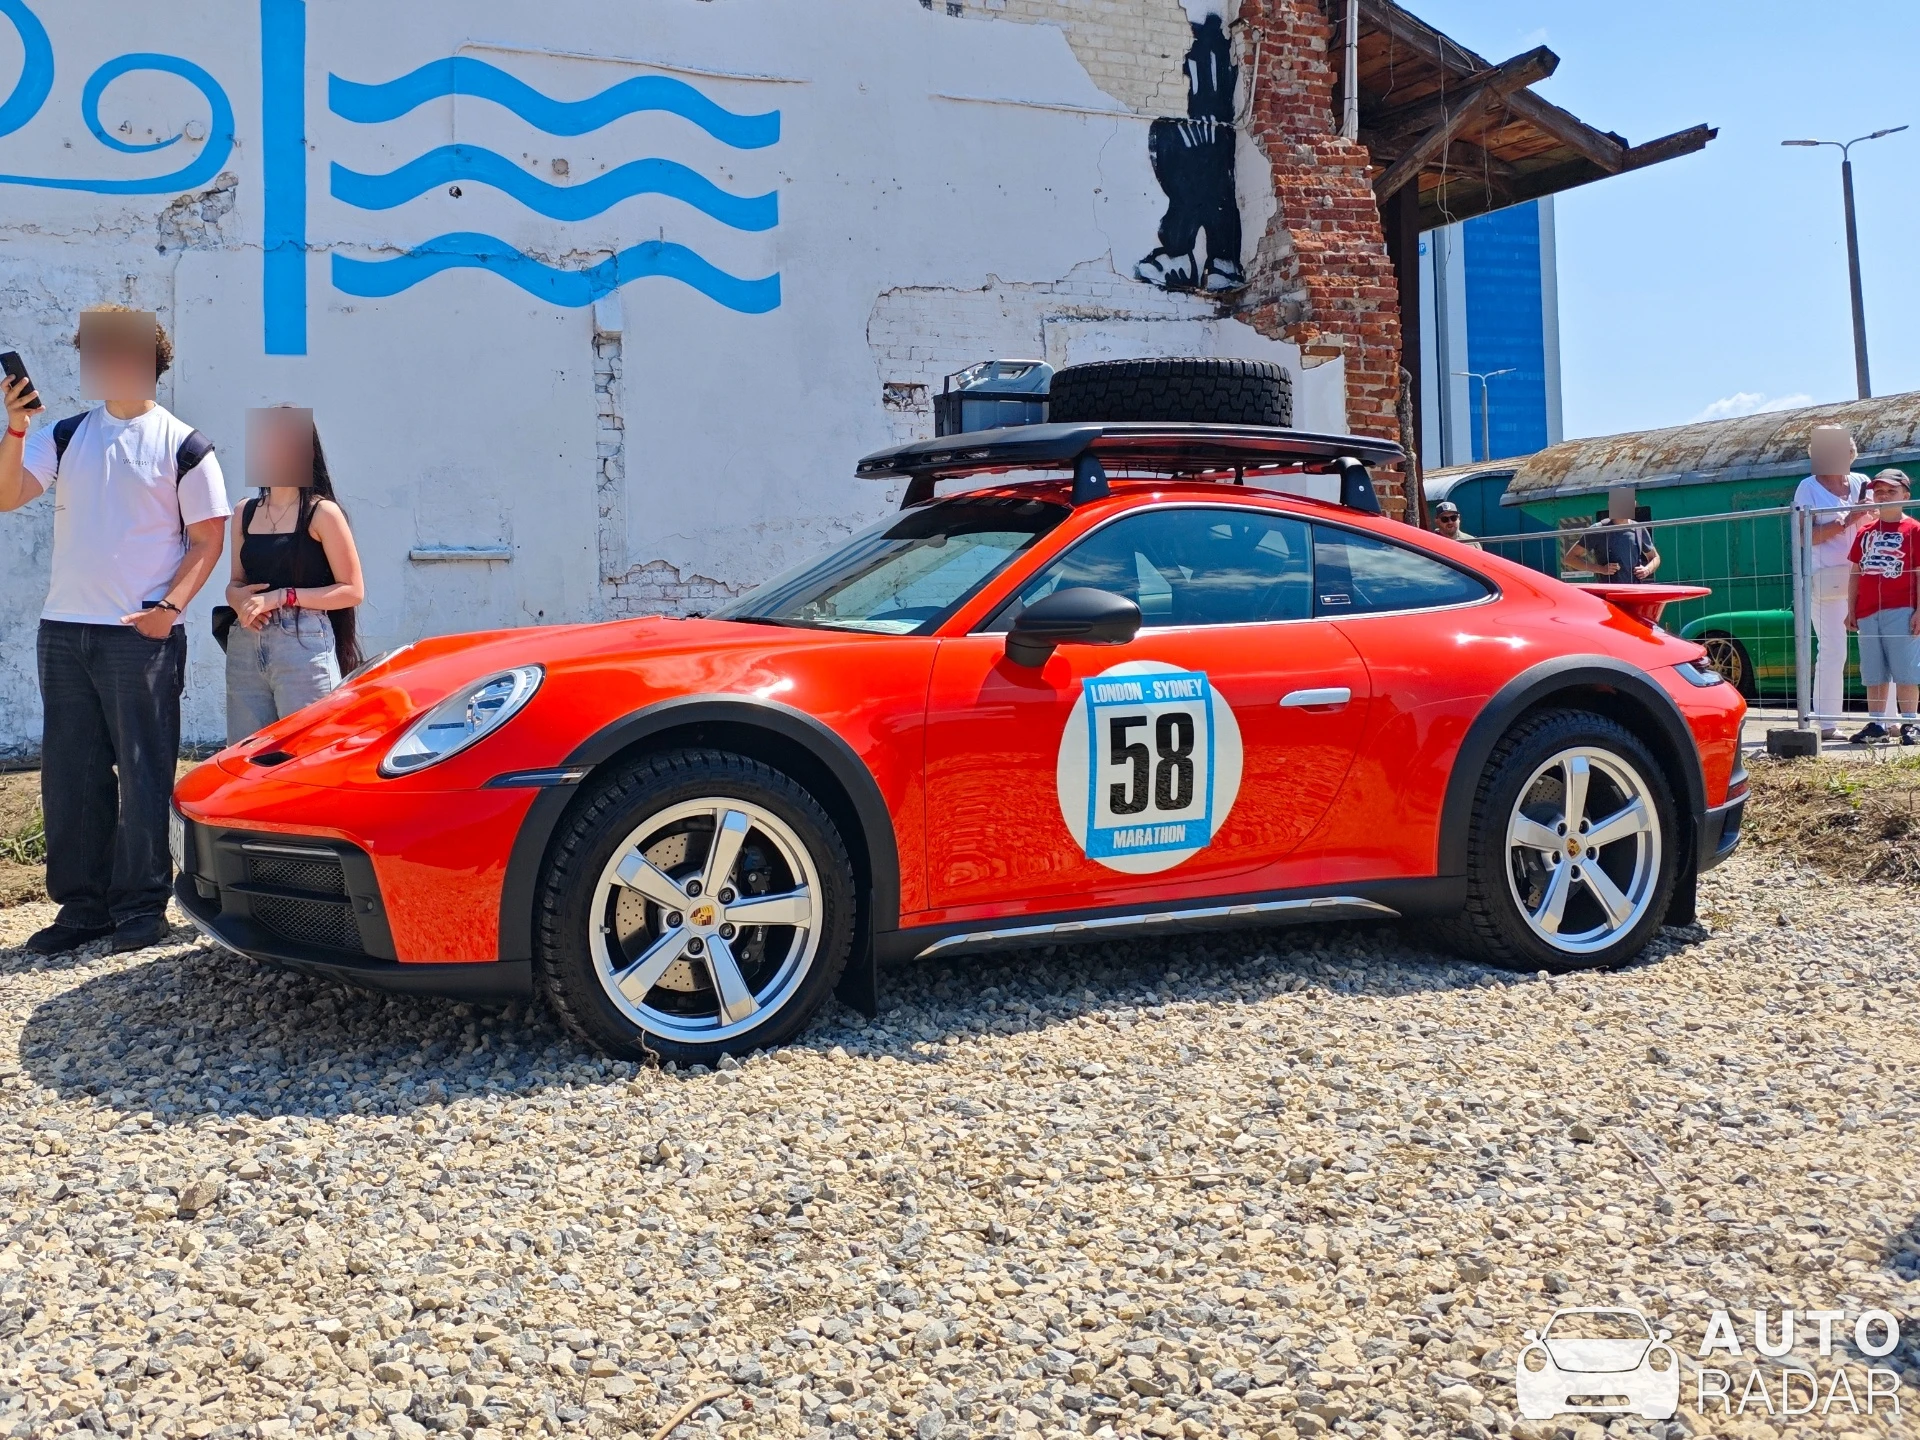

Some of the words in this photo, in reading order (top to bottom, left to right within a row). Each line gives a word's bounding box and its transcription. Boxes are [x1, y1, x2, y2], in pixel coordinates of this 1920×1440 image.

[1090, 681, 1143, 703] LONDON
[1152, 679, 1202, 699] SYDNEY
[1109, 712, 1195, 815] 58
[1113, 825, 1186, 849] MARATHON
